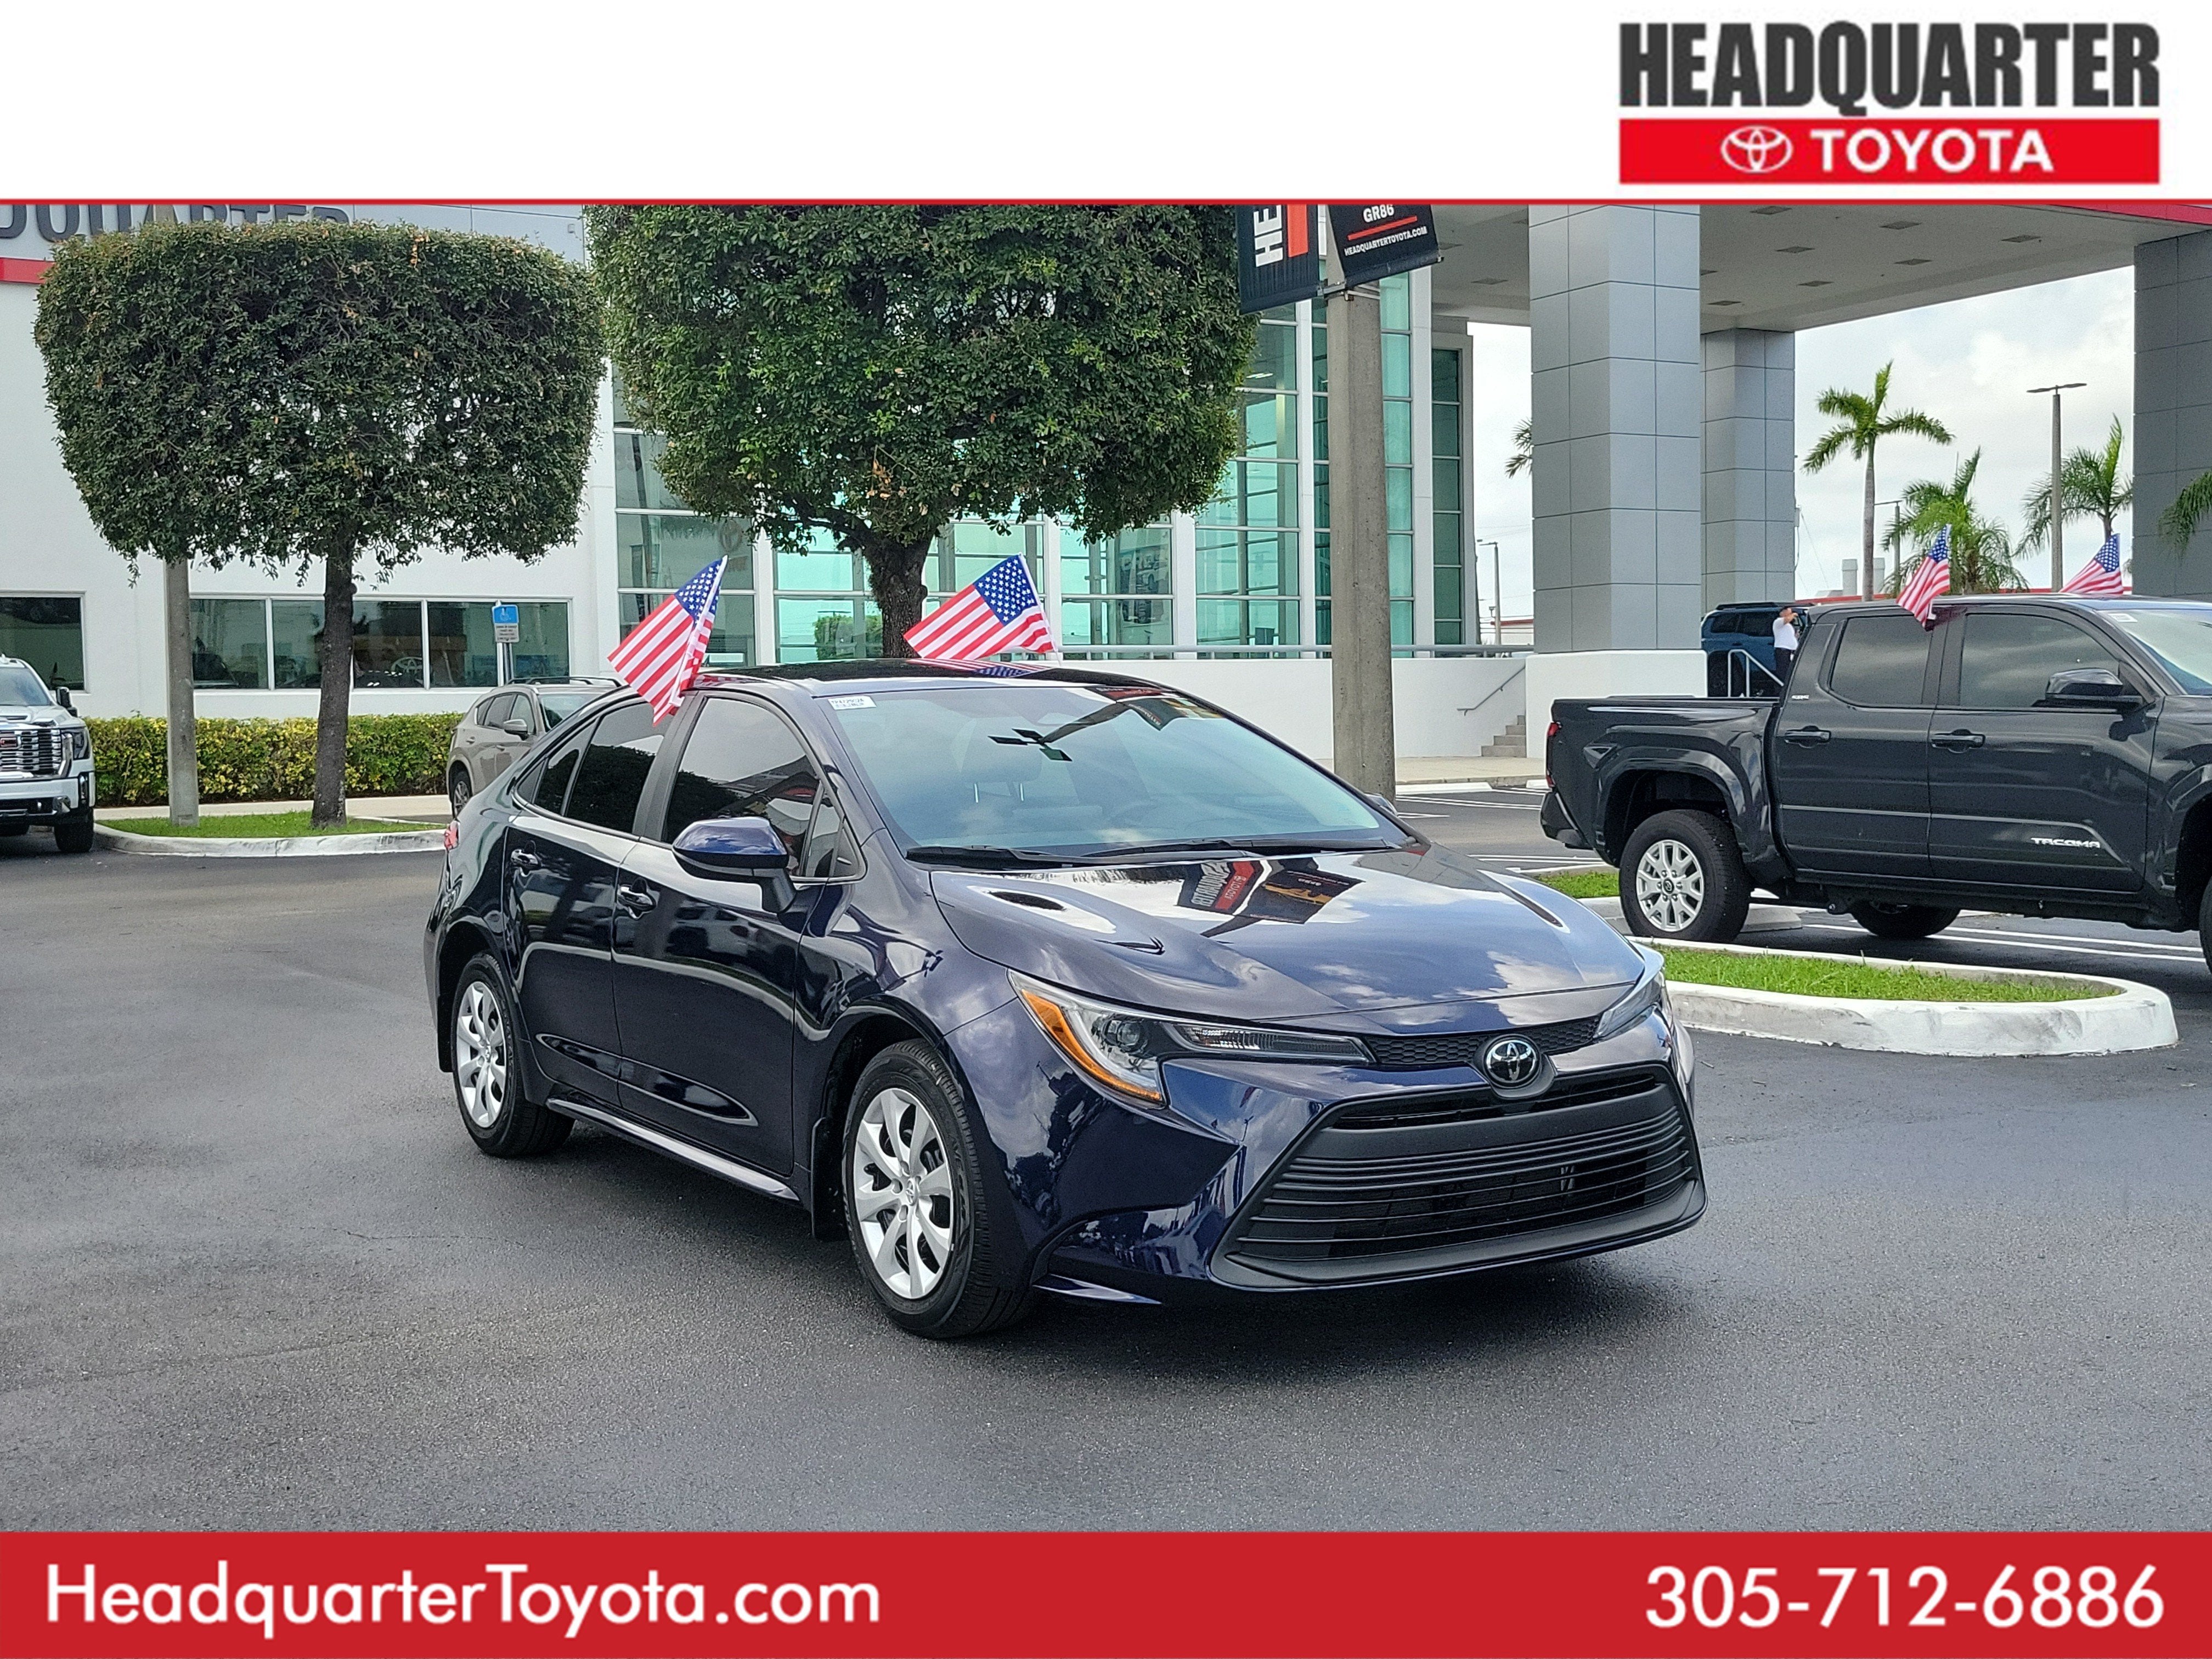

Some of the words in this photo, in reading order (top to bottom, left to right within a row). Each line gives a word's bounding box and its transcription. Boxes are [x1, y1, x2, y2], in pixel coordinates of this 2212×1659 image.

[1363, 204, 1395, 223] GR86
[1344, 225, 1427, 256] HEADQUARTERTOYOTA.COM
[2031, 837, 2101, 849] TACOMA
